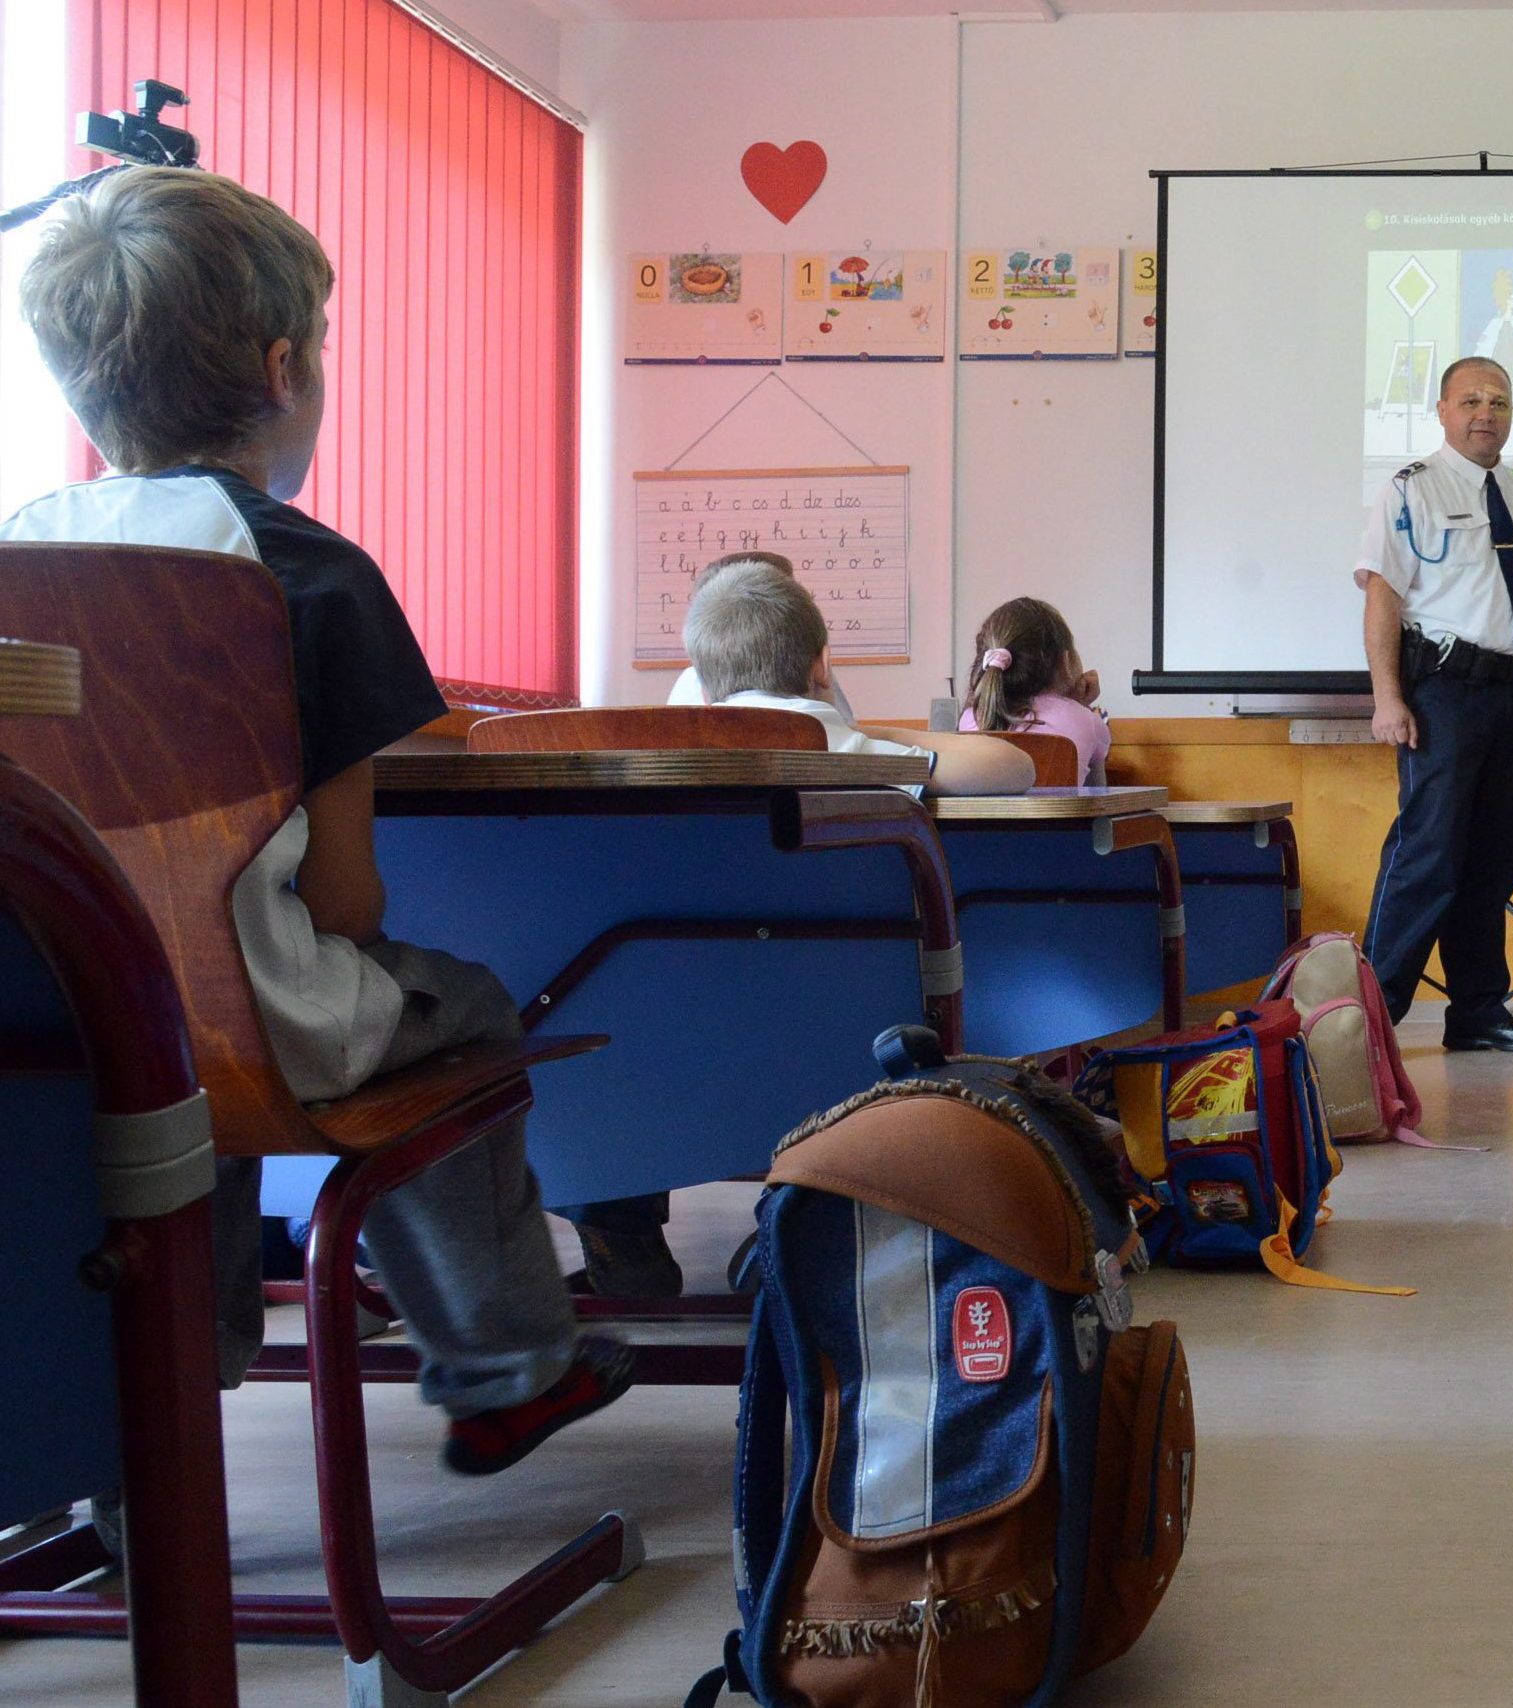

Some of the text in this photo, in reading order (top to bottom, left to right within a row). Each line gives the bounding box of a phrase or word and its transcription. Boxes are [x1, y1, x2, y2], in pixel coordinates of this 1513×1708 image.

[641, 265, 657, 287] 0
[802, 262, 811, 284] 1
[974, 259, 990, 282] 2
[1139, 257, 1155, 280] 3
[659, 501, 671, 512] a
[705, 491, 720, 511] b
[732, 499, 742, 510] c
[752, 499, 768, 510] cs
[780, 490, 792, 510] d
[803, 488, 822, 509] dz
[834, 488, 861, 508] dzs
[659, 531, 668, 542] e
[697, 522, 706, 551] f
[716, 530, 727, 550] g
[739, 529, 760, 550] gy
[773, 520, 788, 540] h
[860, 518, 875, 538] k
[661, 554, 671, 573] l
[679, 553, 698, 581] ly
[801, 559, 814, 570] o
[845, 619, 862, 631] zs
[963, 1339, 1001, 1350] Step by Step
